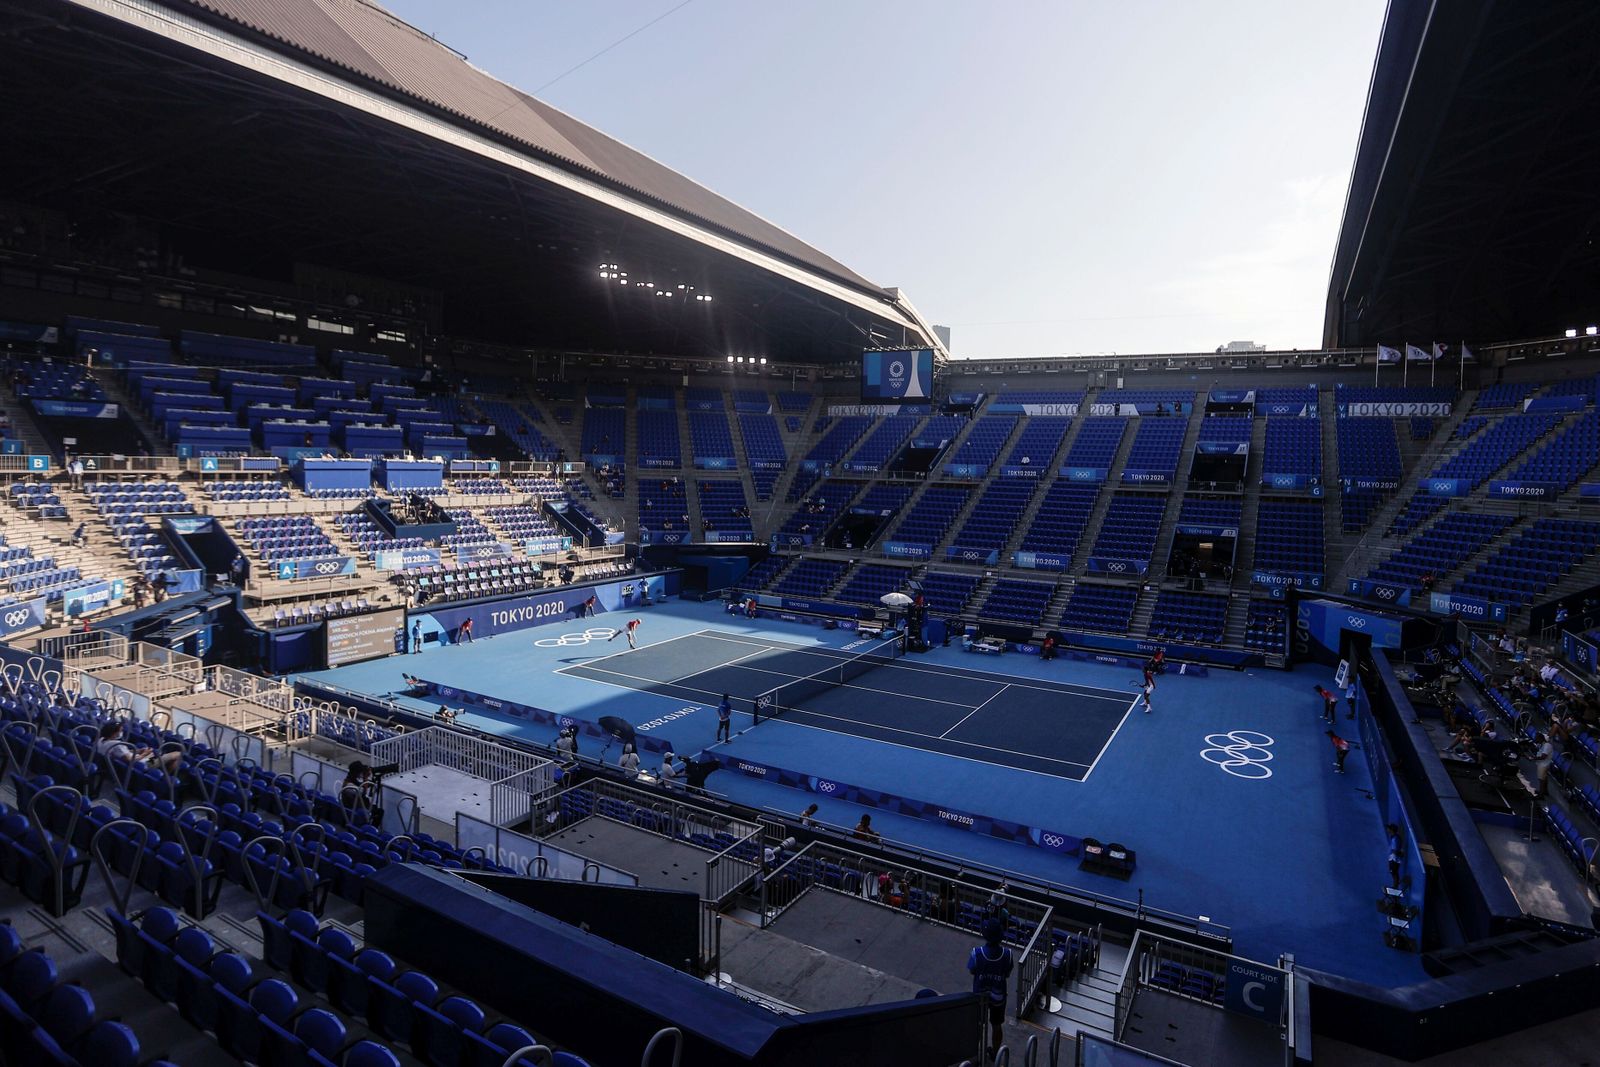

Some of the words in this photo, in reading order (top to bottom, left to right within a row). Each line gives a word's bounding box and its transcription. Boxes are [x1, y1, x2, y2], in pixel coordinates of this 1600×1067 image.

[1038, 403, 1078, 416] TOKYO
[1089, 403, 1119, 416] 202
[1350, 403, 1404, 416] TOKYO
[1408, 403, 1451, 416] 2020
[7, 444, 15, 454] J
[33, 459, 44, 469] B
[205, 460, 215, 470] A
[1357, 480, 1380, 489] TOKYO
[1380, 480, 1398, 489] 2020
[1313, 487, 1320, 496] G
[1500, 486, 1524, 494] TOKYO
[1524, 486, 1545, 496] 2020
[746, 533, 751, 541] H
[564, 539, 569, 547] A
[908, 547, 923, 555] 2020
[388, 555, 411, 564] TOKYO
[412, 554, 431, 563] 2020
[1023, 556, 1044, 564] TOKYO
[1044, 558, 1060, 566] 2020
[282, 565, 292, 575] A
[1256, 575, 1281, 585] TOKYO
[1282, 575, 1302, 586] 2020
[1311, 577, 1319, 586] G
[114, 584, 122, 595] B
[1352, 582, 1358, 591] F
[1272, 588, 1280, 597] G
[1434, 598, 1461, 611] TOKYO
[1461, 602, 1484, 616] 2020
[490, 605, 534, 627] TOKYO
[535, 600, 565, 619] 2020
[1494, 608, 1502, 618] F
[1295, 607, 1311, 655] 2020
[664, 705, 702, 720] TOKYO
[637, 718, 668, 731] 2020
[739, 762, 754, 772] TOKYO
[754, 766, 767, 775] 2020
[938, 810, 958, 821] TOKYO
[958, 815, 974, 825] 2020
[1231, 965, 1259, 979] COURT
[1260, 973, 1280, 985] SIDE
[1242, 981, 1266, 1013] C
